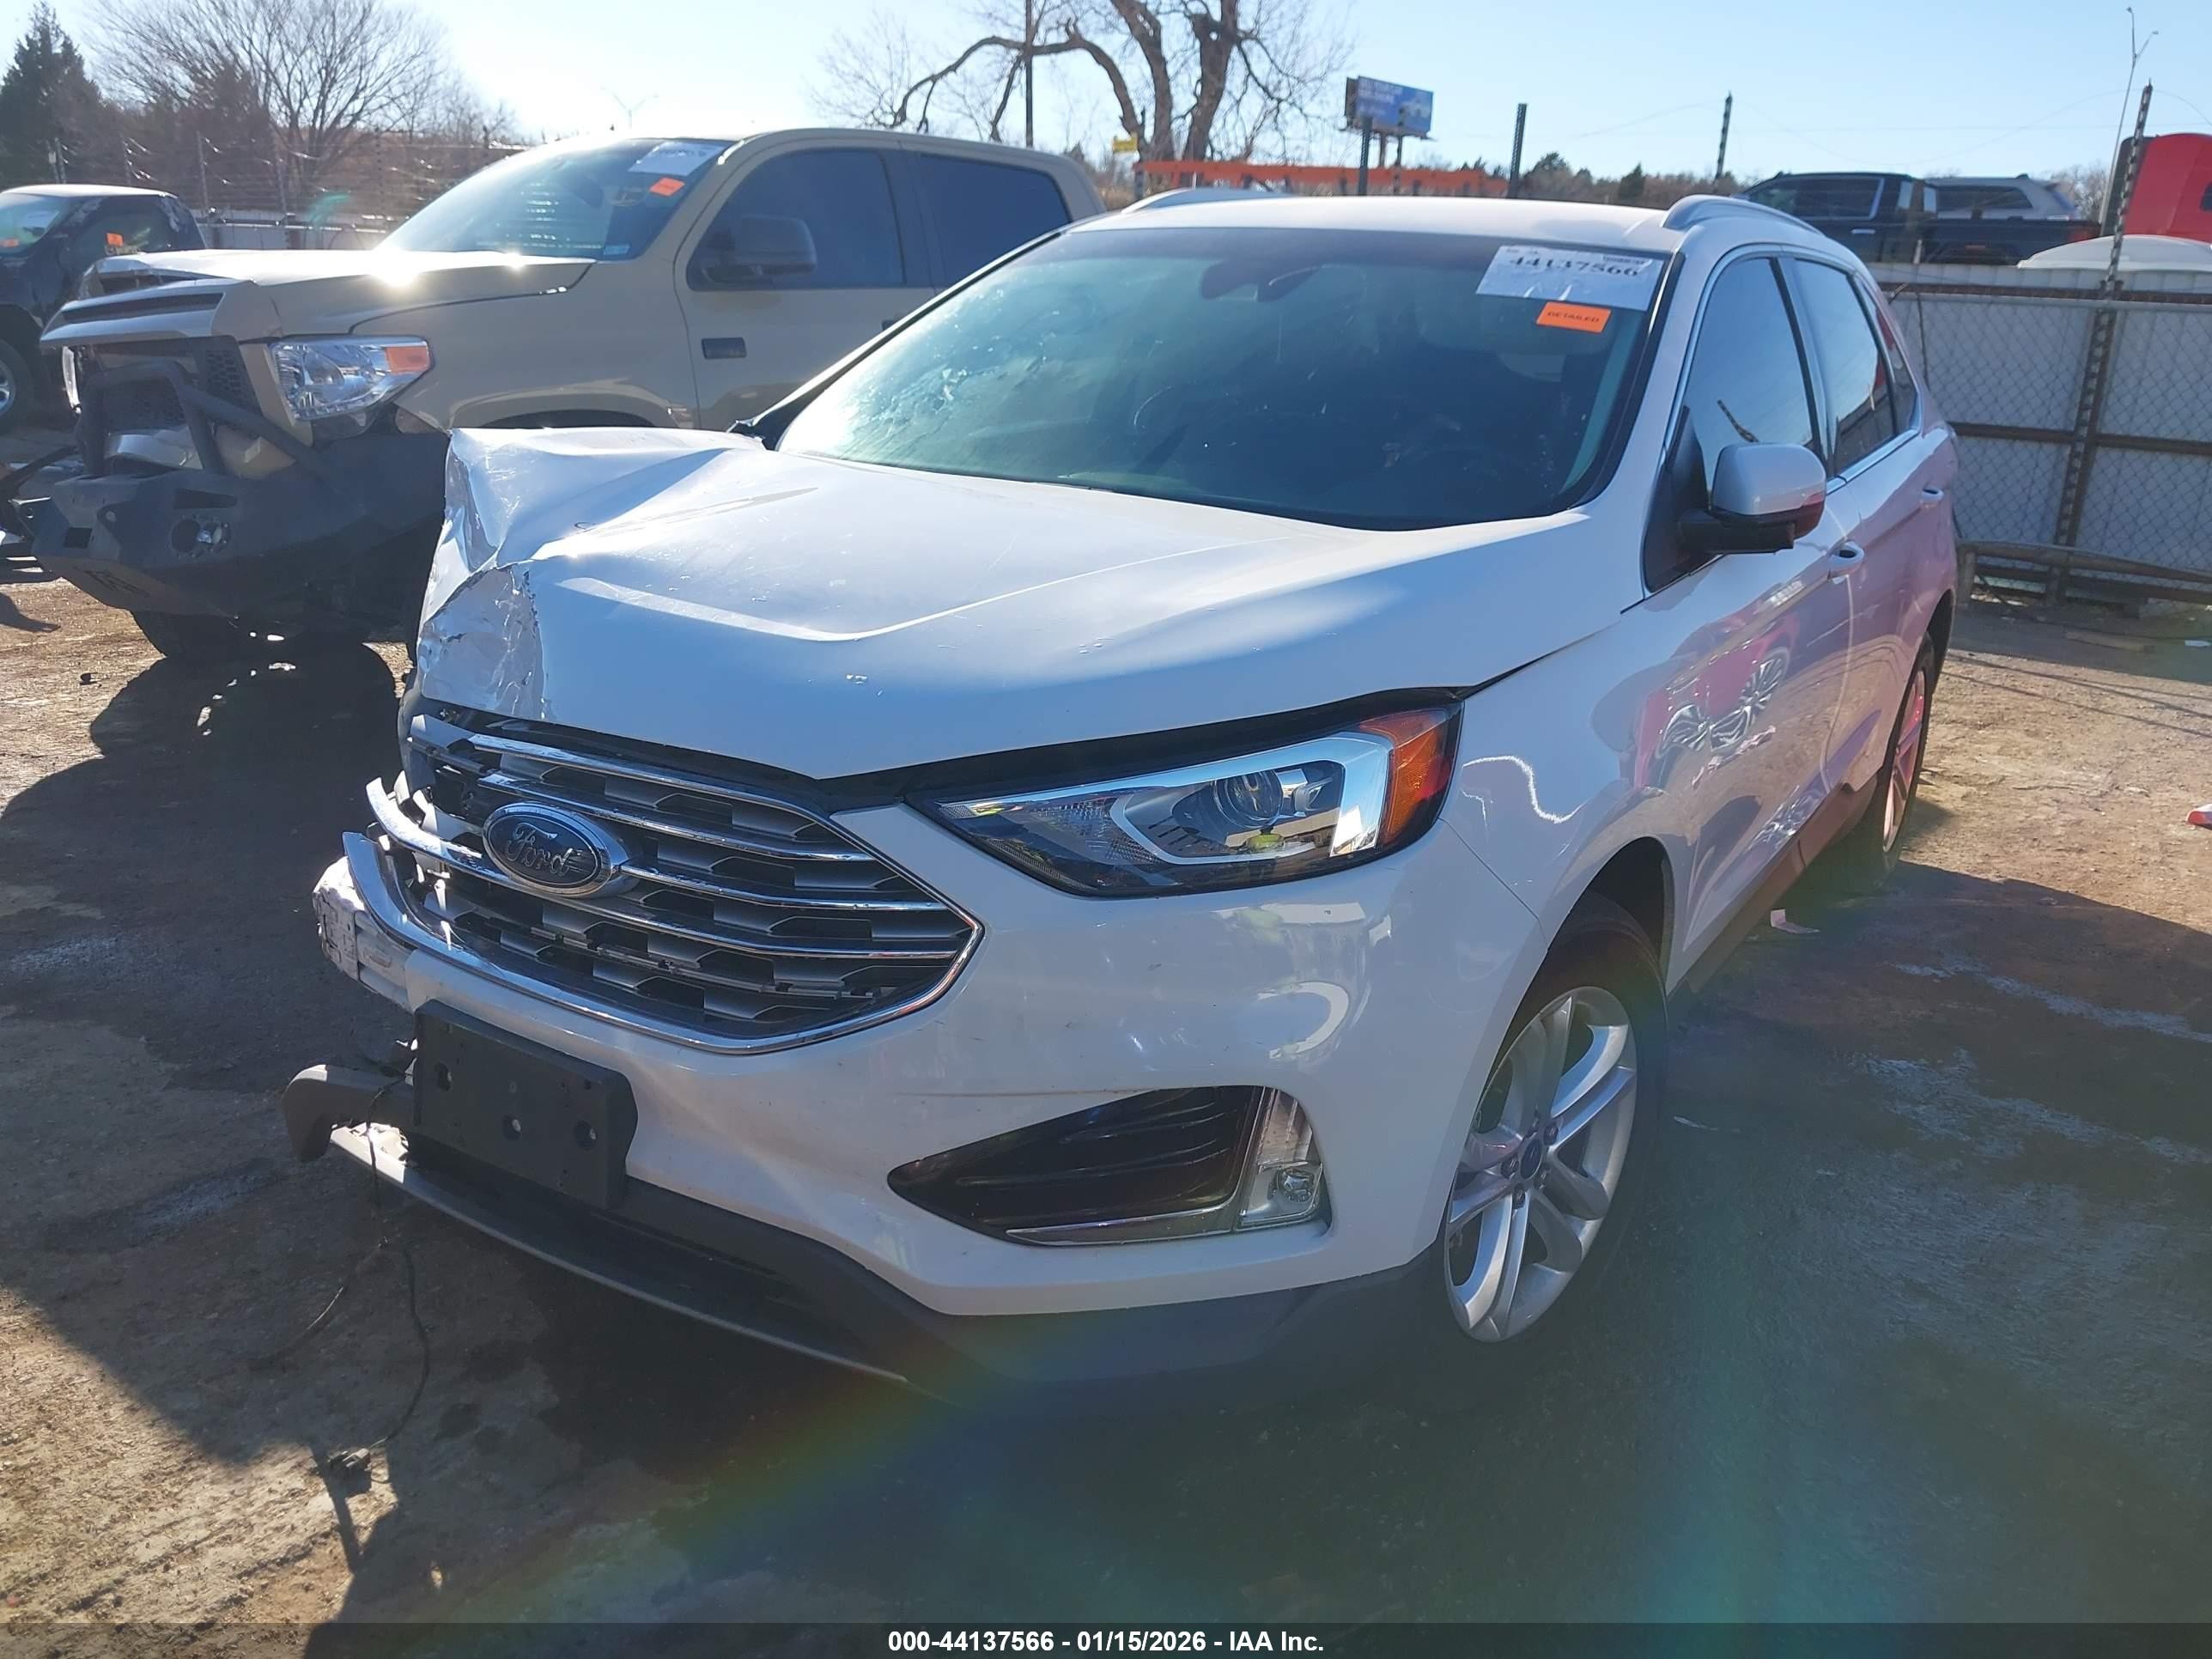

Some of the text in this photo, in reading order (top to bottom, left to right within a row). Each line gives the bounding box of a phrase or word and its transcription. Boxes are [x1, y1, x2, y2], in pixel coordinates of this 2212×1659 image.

[1509, 257, 1639, 276] 44137566
[1547, 311, 1601, 323] DETAILED
[506, 822, 575, 877] Ford
